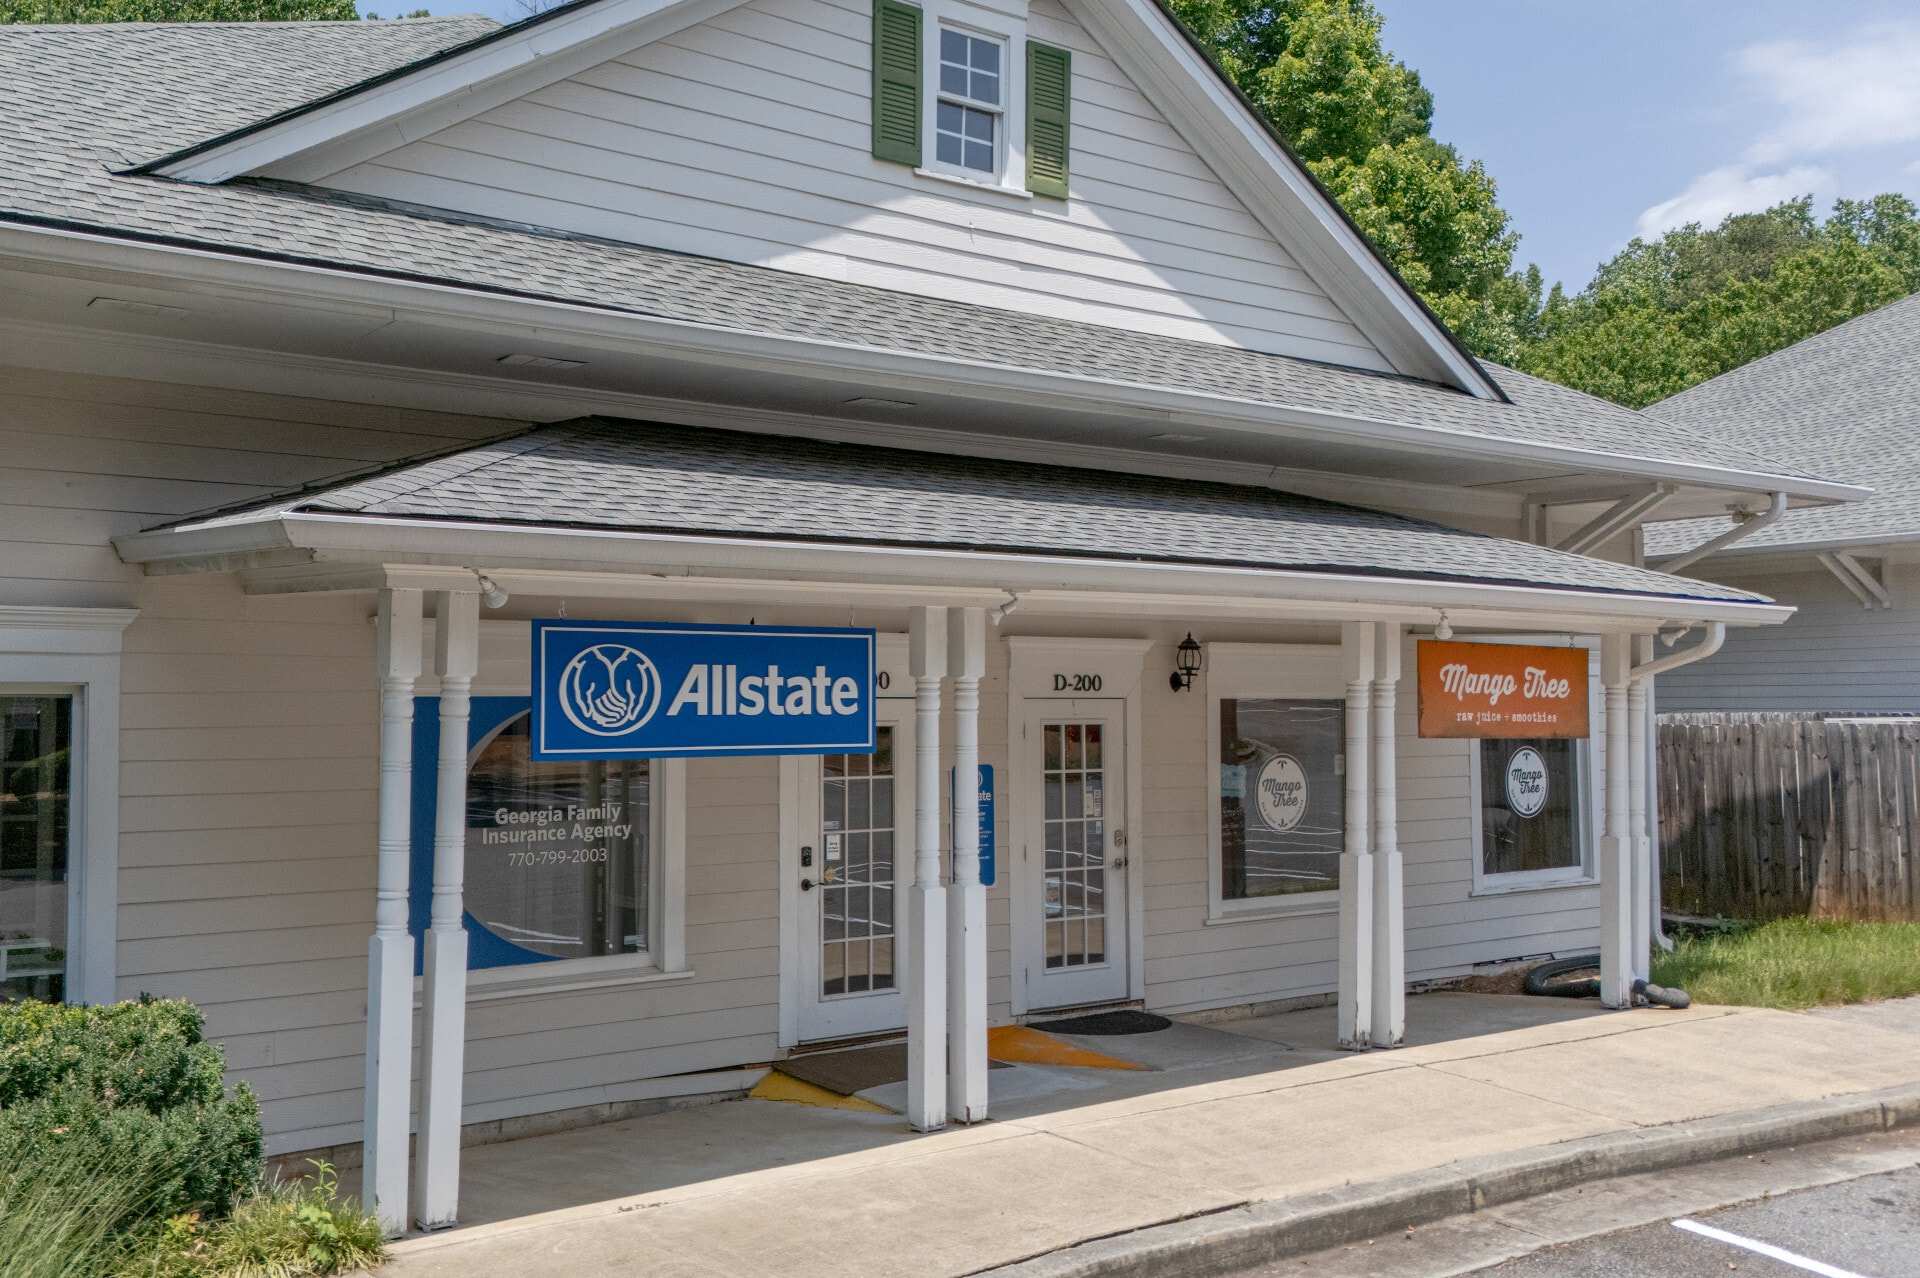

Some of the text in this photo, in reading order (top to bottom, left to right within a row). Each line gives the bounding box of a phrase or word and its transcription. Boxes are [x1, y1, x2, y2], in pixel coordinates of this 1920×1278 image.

[666, 664, 859, 716] Allstate
[1053, 674, 1102, 691] D-200
[1440, 663, 1570, 706] Mango Tree
[1456, 712, 1473, 722] raw
[1476, 711, 1501, 725] juice
[1511, 712, 1557, 723] smoothies
[1511, 768, 1543, 784] Mango
[1262, 778, 1302, 796] Mango
[1520, 781, 1540, 794] Tree
[1273, 791, 1299, 807] Tree
[495, 803, 621, 827] Georgia Family
[482, 823, 631, 844] Insurance Agency
[508, 848, 607, 867] 770-799-2003
